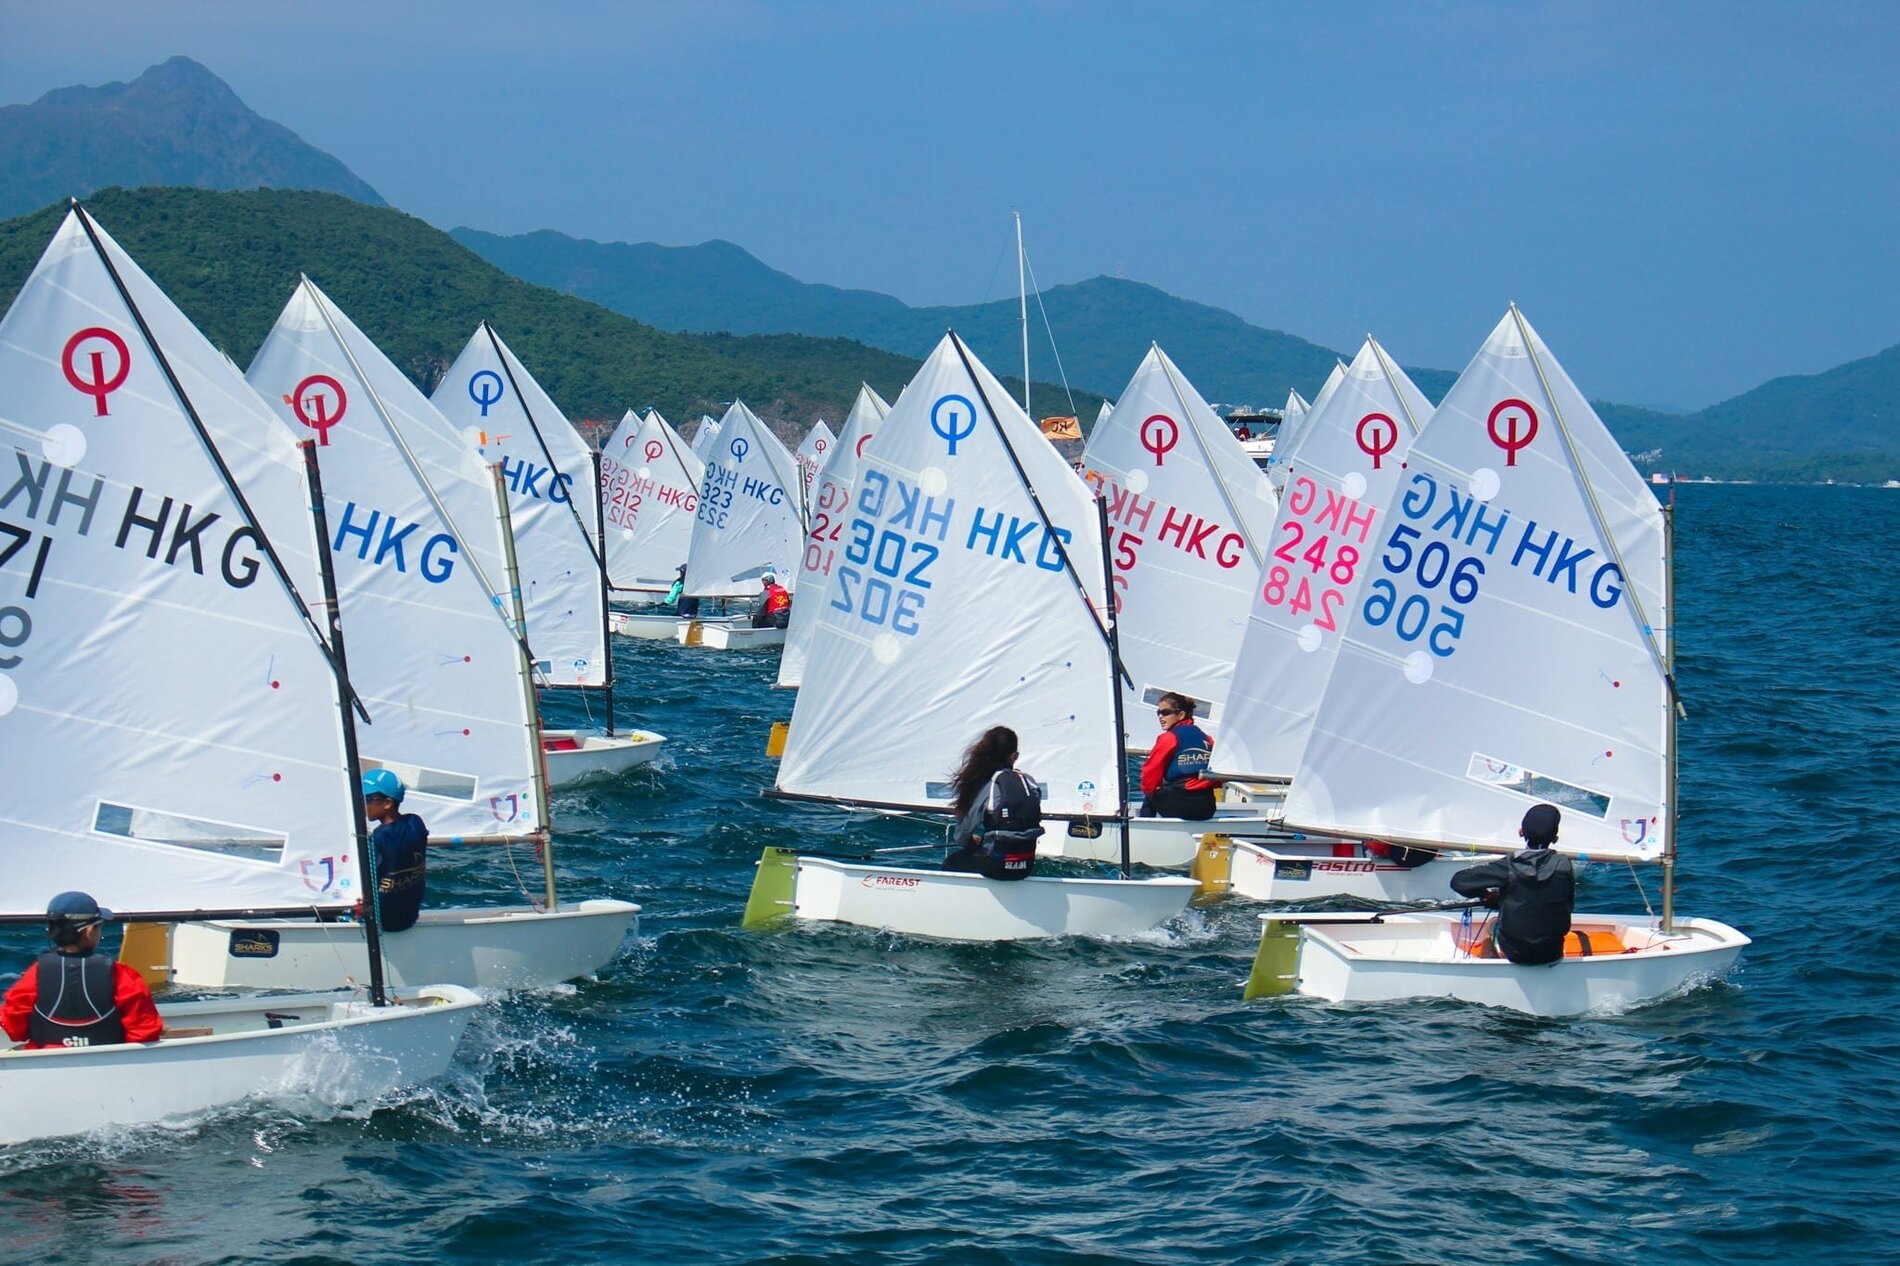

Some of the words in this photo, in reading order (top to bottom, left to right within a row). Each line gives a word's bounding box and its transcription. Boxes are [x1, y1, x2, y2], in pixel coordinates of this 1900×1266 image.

[501, 456, 573, 503] HKG
[702, 482, 733, 508] 323
[743, 477, 784, 505] HKG
[612, 487, 642, 512] 212
[657, 485, 698, 512] HKG
[115, 486, 265, 588] HKG
[333, 502, 457, 583] HKG
[846, 518, 939, 589] 302
[966, 507, 1072, 572] HKG
[1158, 506, 1244, 568] HKG
[1274, 521, 1359, 585] 248
[1382, 524, 1485, 604] 506
[1510, 520, 1625, 609] HKG
[1178, 753, 1210, 762] SHAR
[876, 876, 920, 886] FAREAST
[1004, 861, 1026, 869] SLAM
[1318, 861, 1376, 872] astro
[234, 943, 272, 953] SHARKS
